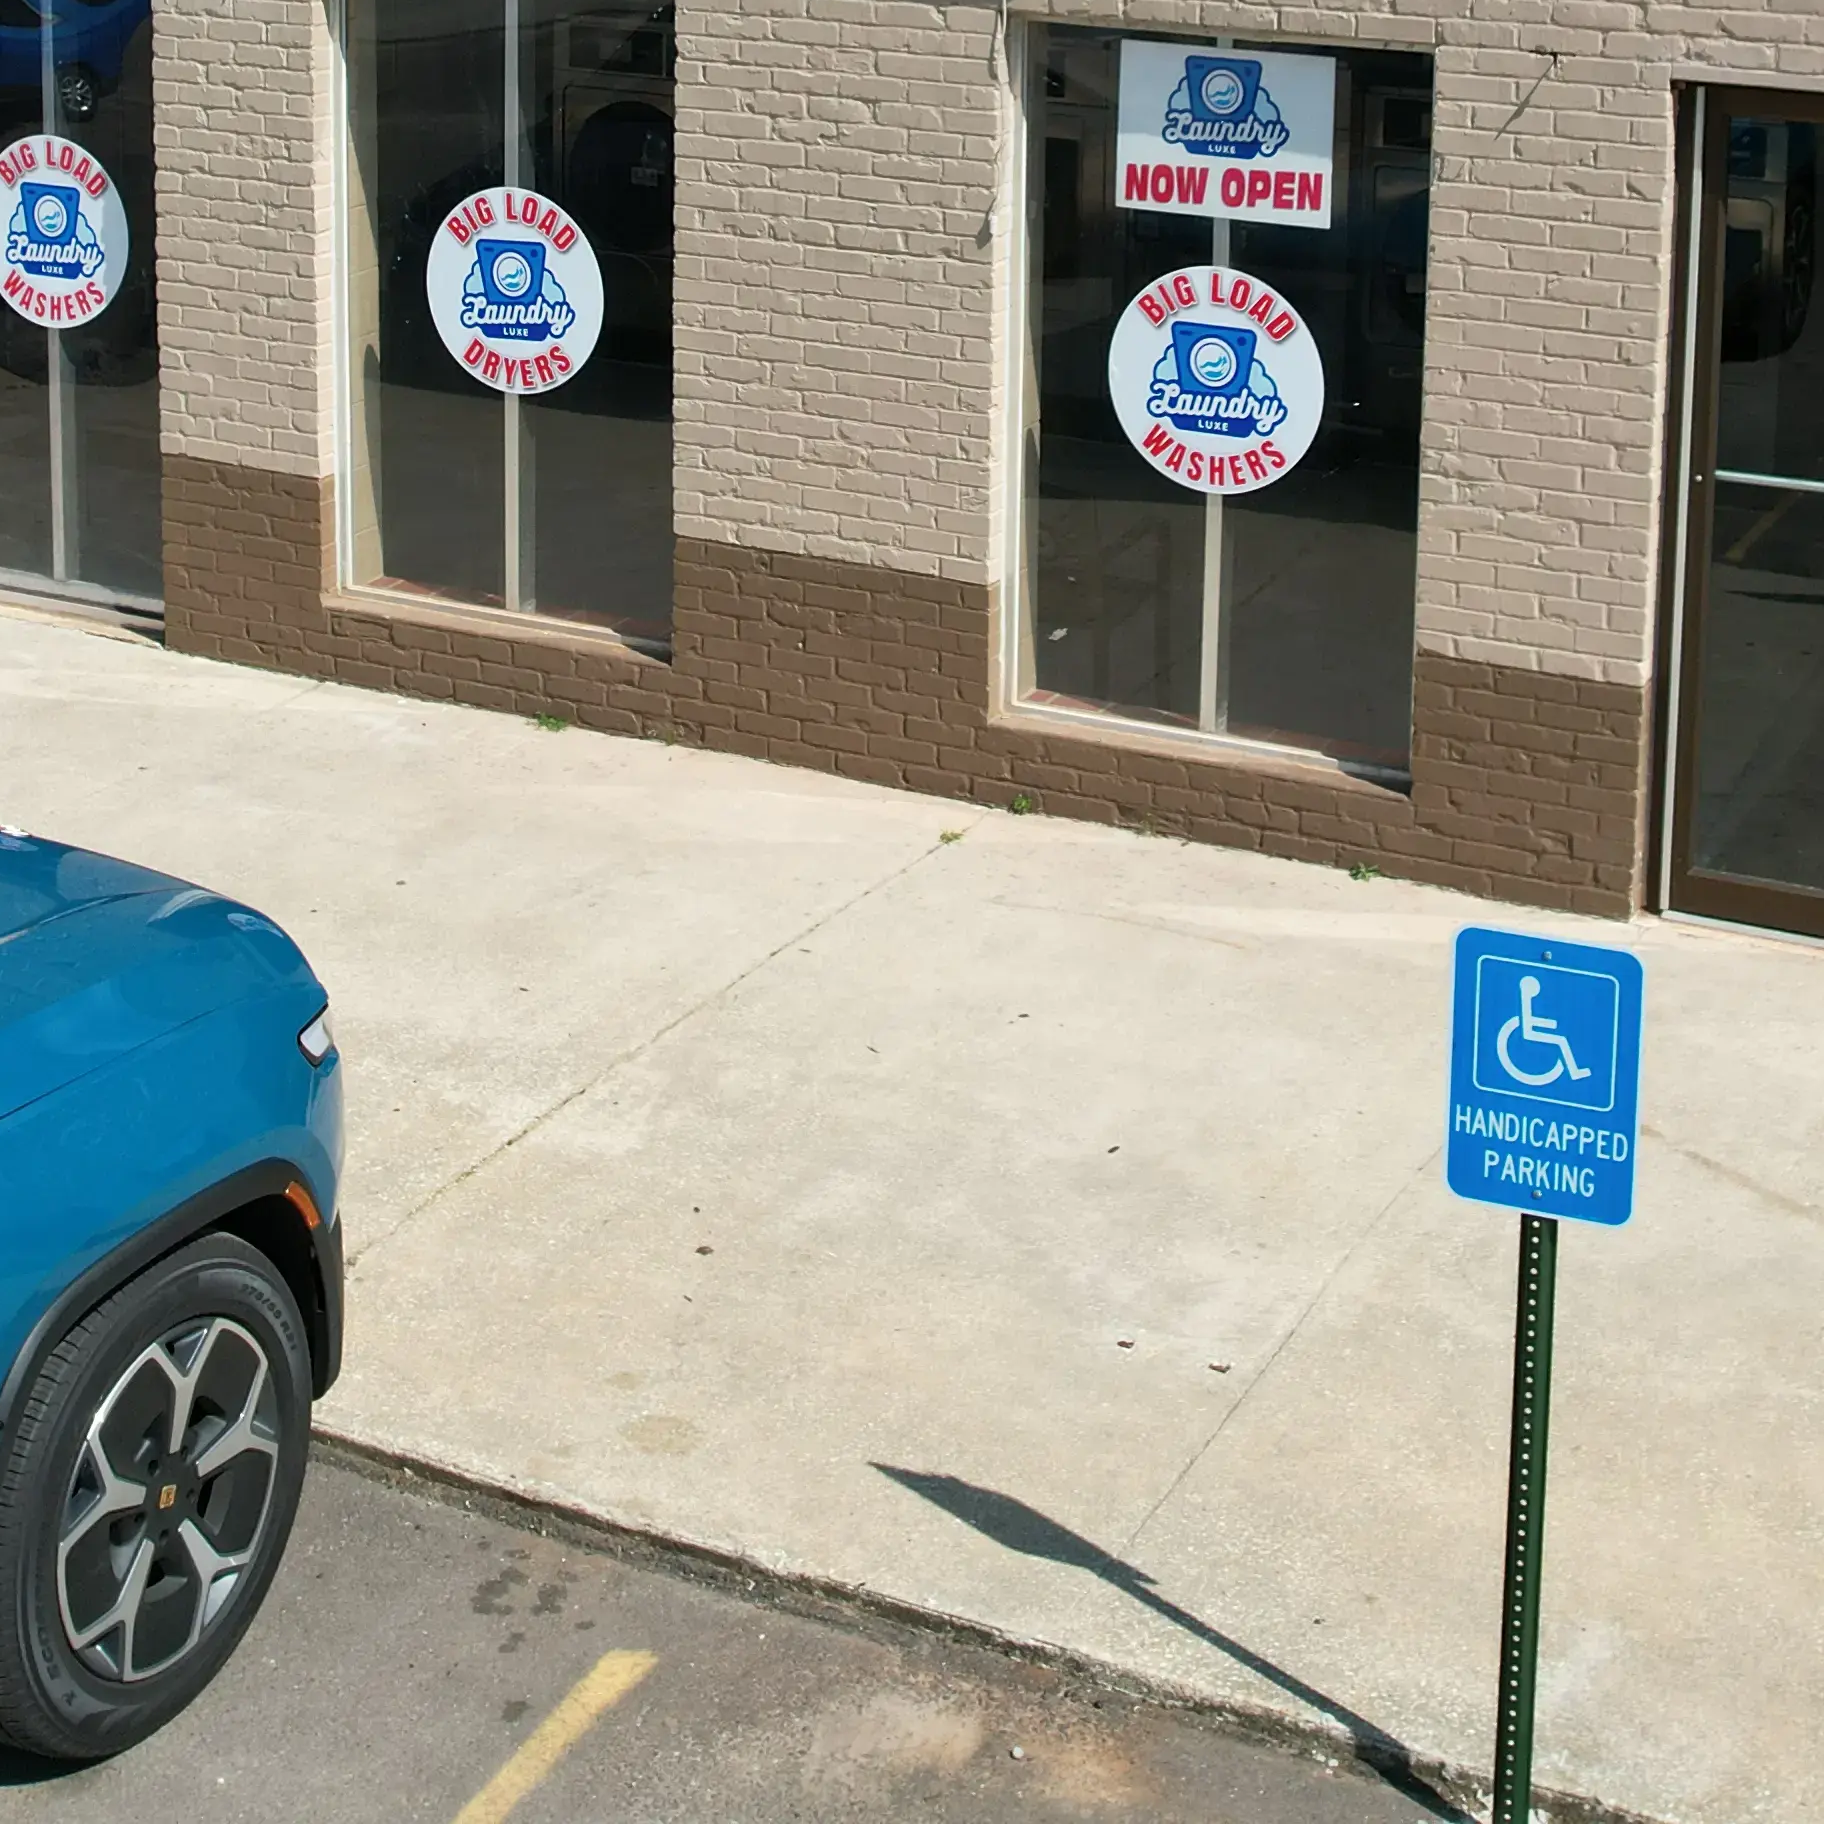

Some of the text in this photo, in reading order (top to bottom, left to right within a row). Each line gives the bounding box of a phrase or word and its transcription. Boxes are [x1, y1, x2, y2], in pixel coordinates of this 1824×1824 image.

[1165, 111, 1286, 154] Laundry
[1207, 144, 1237, 155] LUXE
[45, 141, 107, 197] LOAD
[1124, 163, 1323, 211] NOW OPEN
[446, 192, 576, 251] BIG LOAD
[8, 234, 103, 275] Laundry
[3, 269, 106, 321] WASHERS
[462, 295, 574, 336] Laundry
[1137, 272, 1297, 341] BIG LOAD
[502, 326, 529, 337] LUXE
[462, 337, 571, 387] DRYERS
[1149, 382, 1286, 431] Laundry
[1197, 419, 1229, 432] LUXE
[1142, 423, 1287, 487] WASHERS
[1454, 1103, 1629, 1162] HANDICAPPED
[1483, 1149, 1596, 1199] PARKING
